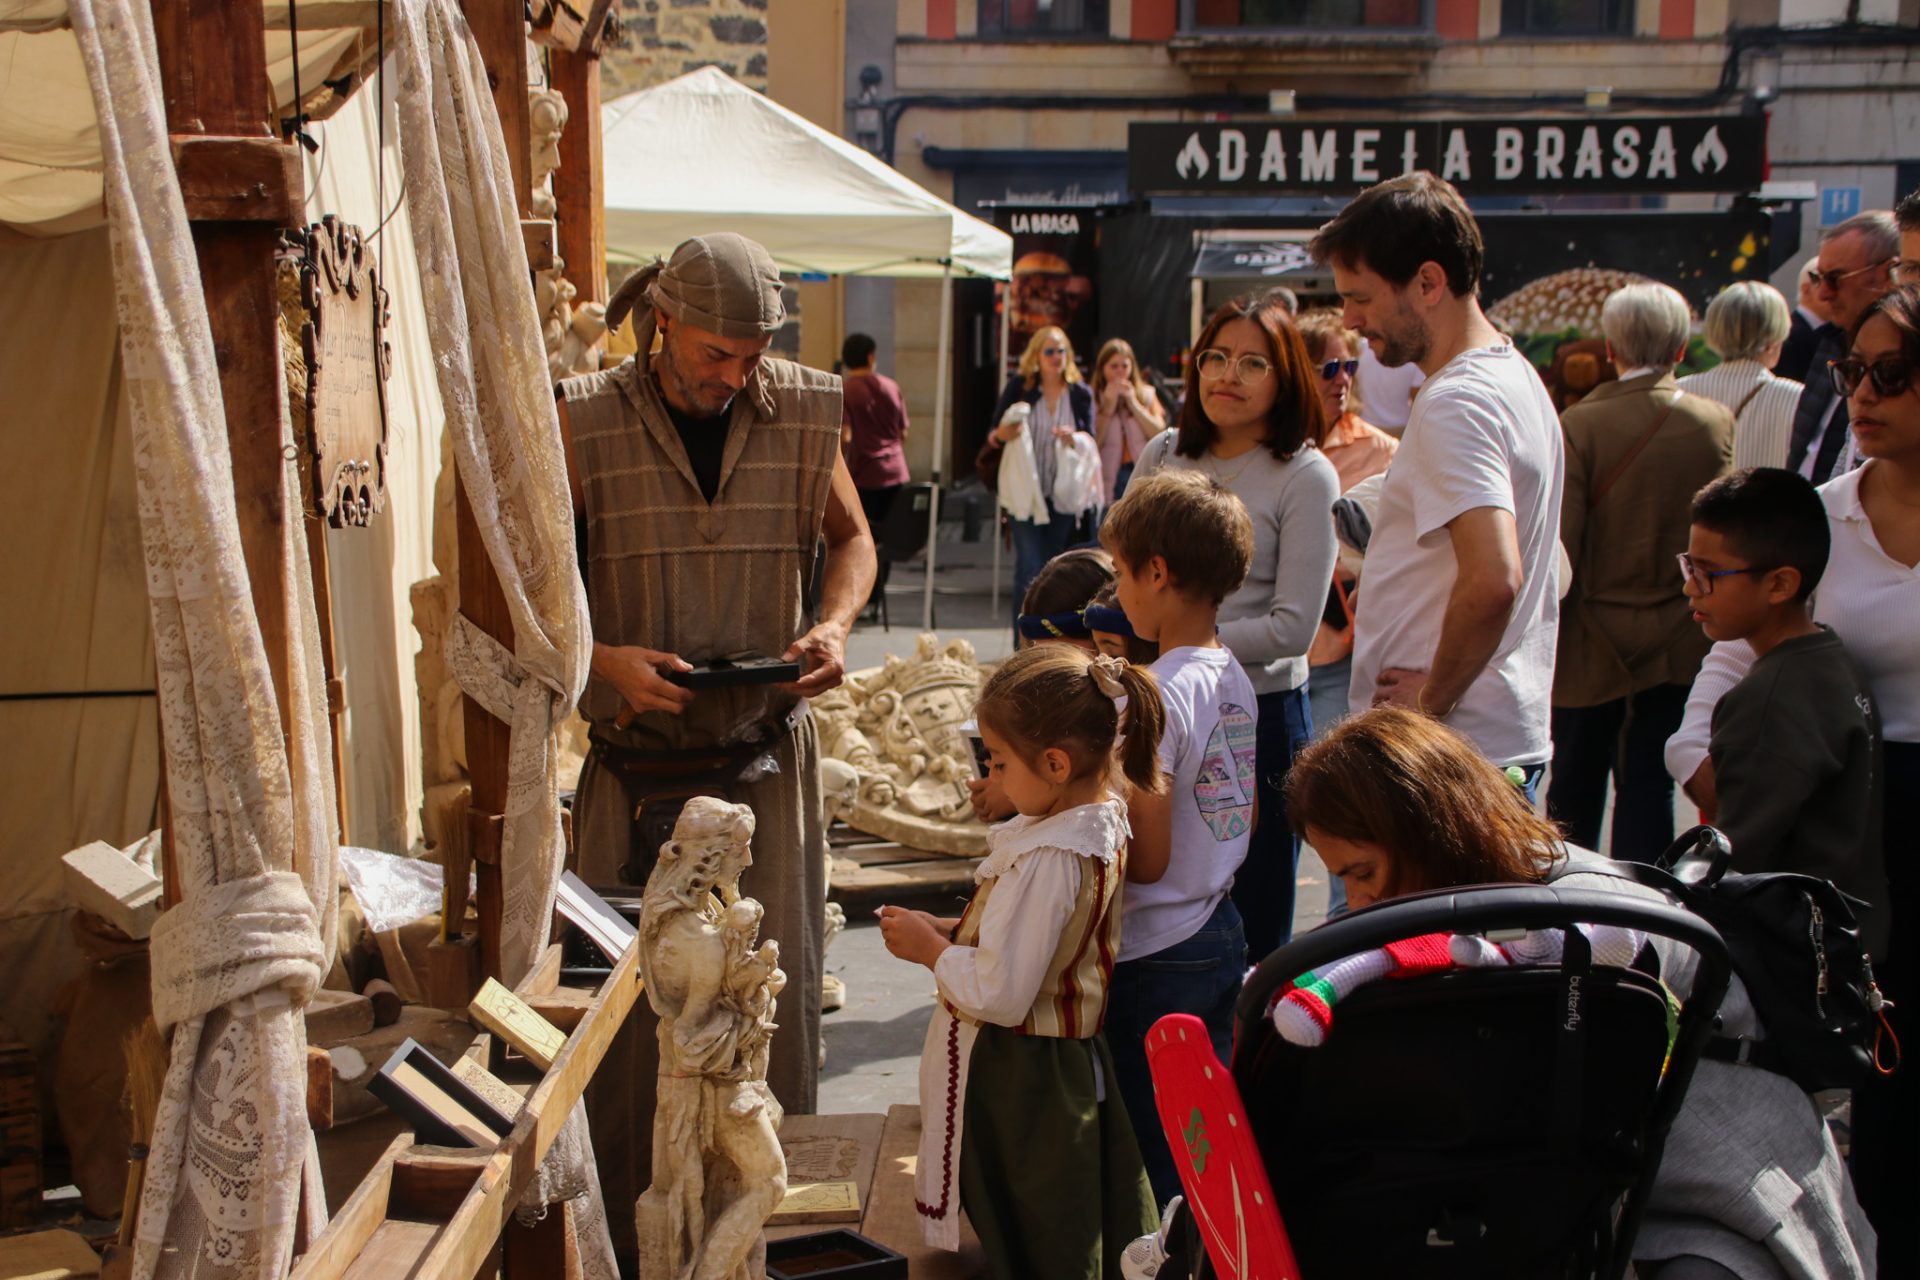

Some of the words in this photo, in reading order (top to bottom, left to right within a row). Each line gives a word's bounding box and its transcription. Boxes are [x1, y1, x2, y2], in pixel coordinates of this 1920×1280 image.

[1217, 129, 1381, 182] DAME
[1493, 125, 1677, 181] BRASA
[1011, 213, 1030, 234] LA
[1031, 213, 1080, 235] BRASA
[1563, 975, 1582, 1031] butterfly
